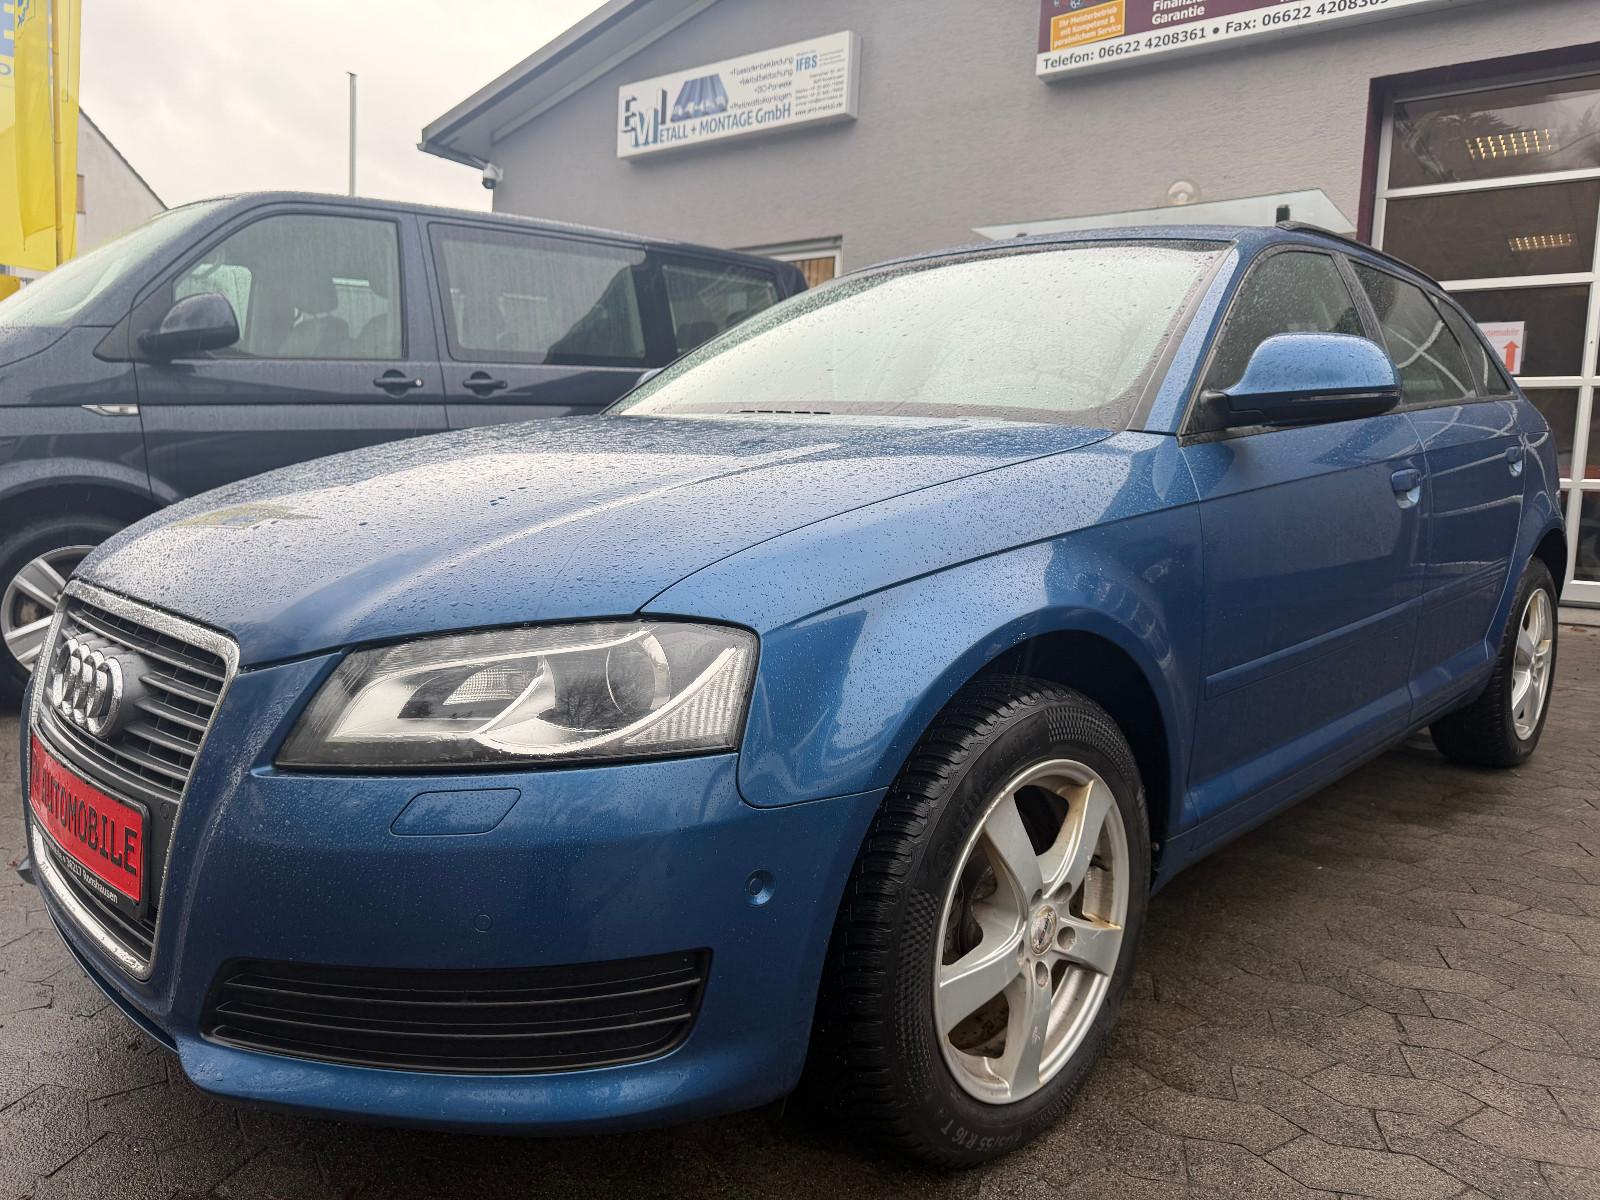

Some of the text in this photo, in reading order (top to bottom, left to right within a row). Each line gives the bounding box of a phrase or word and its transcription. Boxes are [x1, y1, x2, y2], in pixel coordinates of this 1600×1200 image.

[1151, 5, 1206, 25] Garantie
[1043, 52, 1094, 70] Telefon:
[1098, 40, 1140, 59] 06622
[1144, 27, 1206, 49] 4208361
[1225, 18, 1256, 34] Fax:
[1262, 6, 1311, 26] 06622
[796, 55, 818, 73] IFBS
[699, 109, 753, 135] MONTAGE
[755, 102, 792, 125] GmbH
[42, 767, 138, 876] AUTOMOBILE
